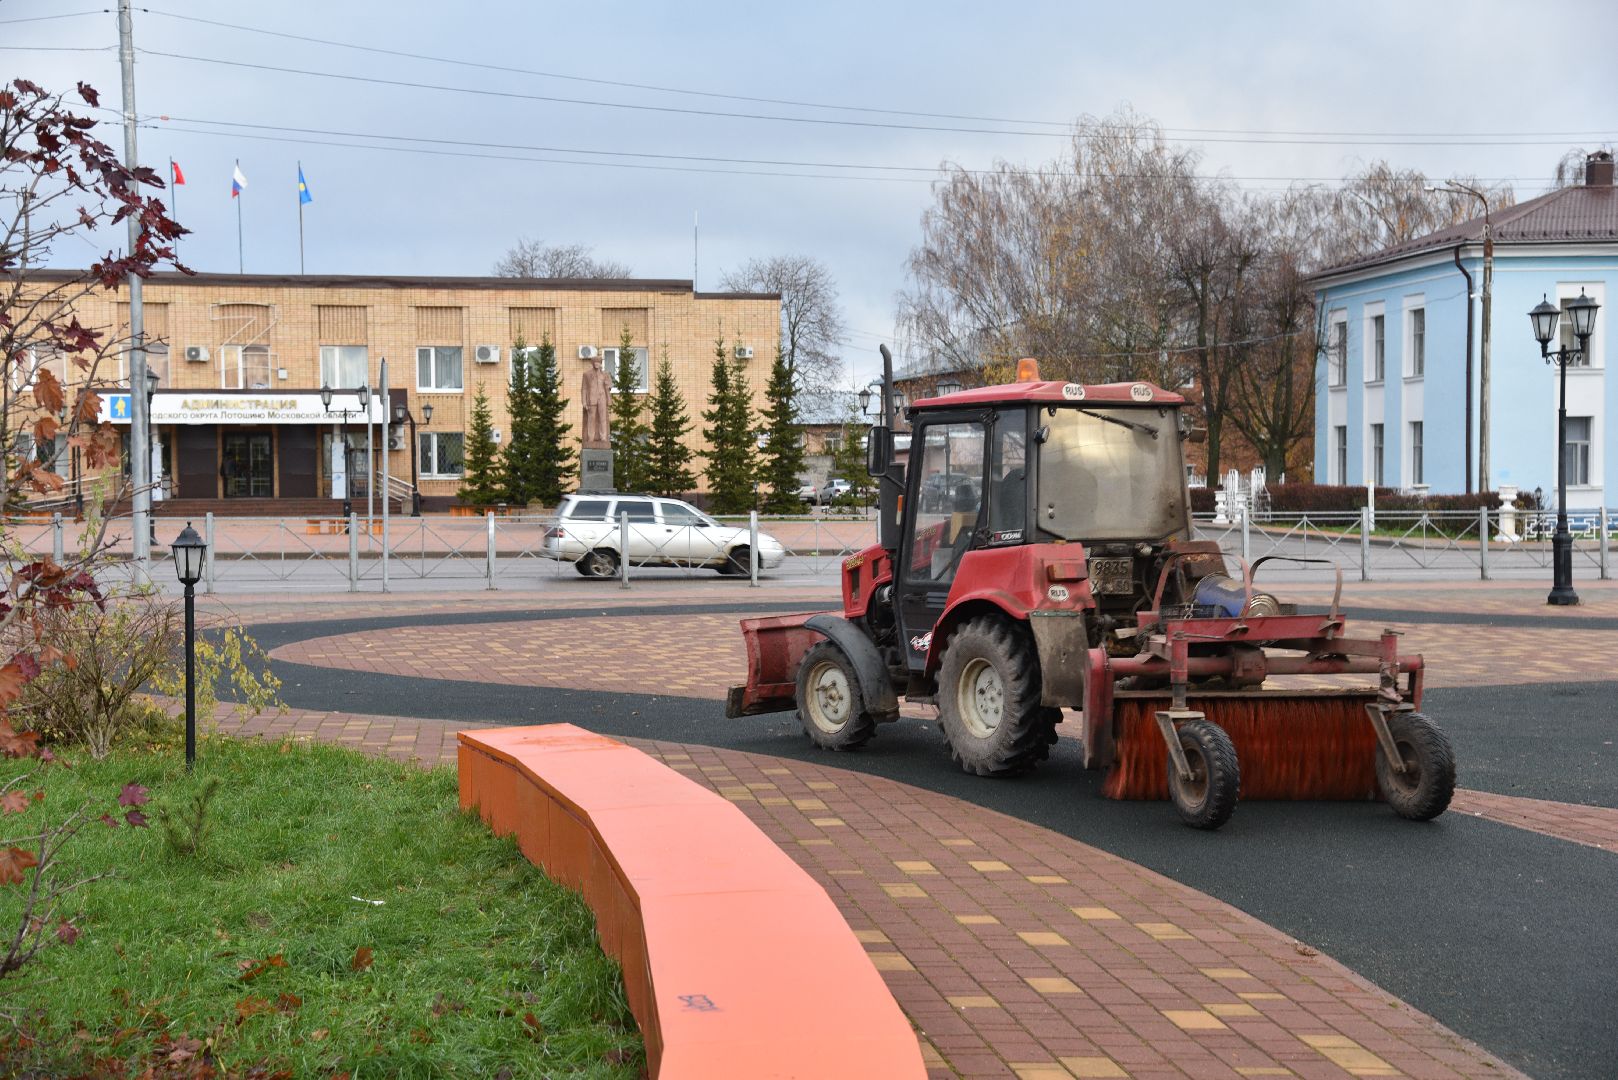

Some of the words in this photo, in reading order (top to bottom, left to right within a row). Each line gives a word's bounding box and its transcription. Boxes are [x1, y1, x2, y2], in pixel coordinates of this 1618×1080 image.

[1065, 386, 1083, 396] RUS
[1133, 387, 1151, 396] RUS
[181, 399, 297, 410] АДМИНИСТРАЦИЯ
[1095, 561, 1129, 575] 9835
[1050, 589, 1067, 597] RUS
